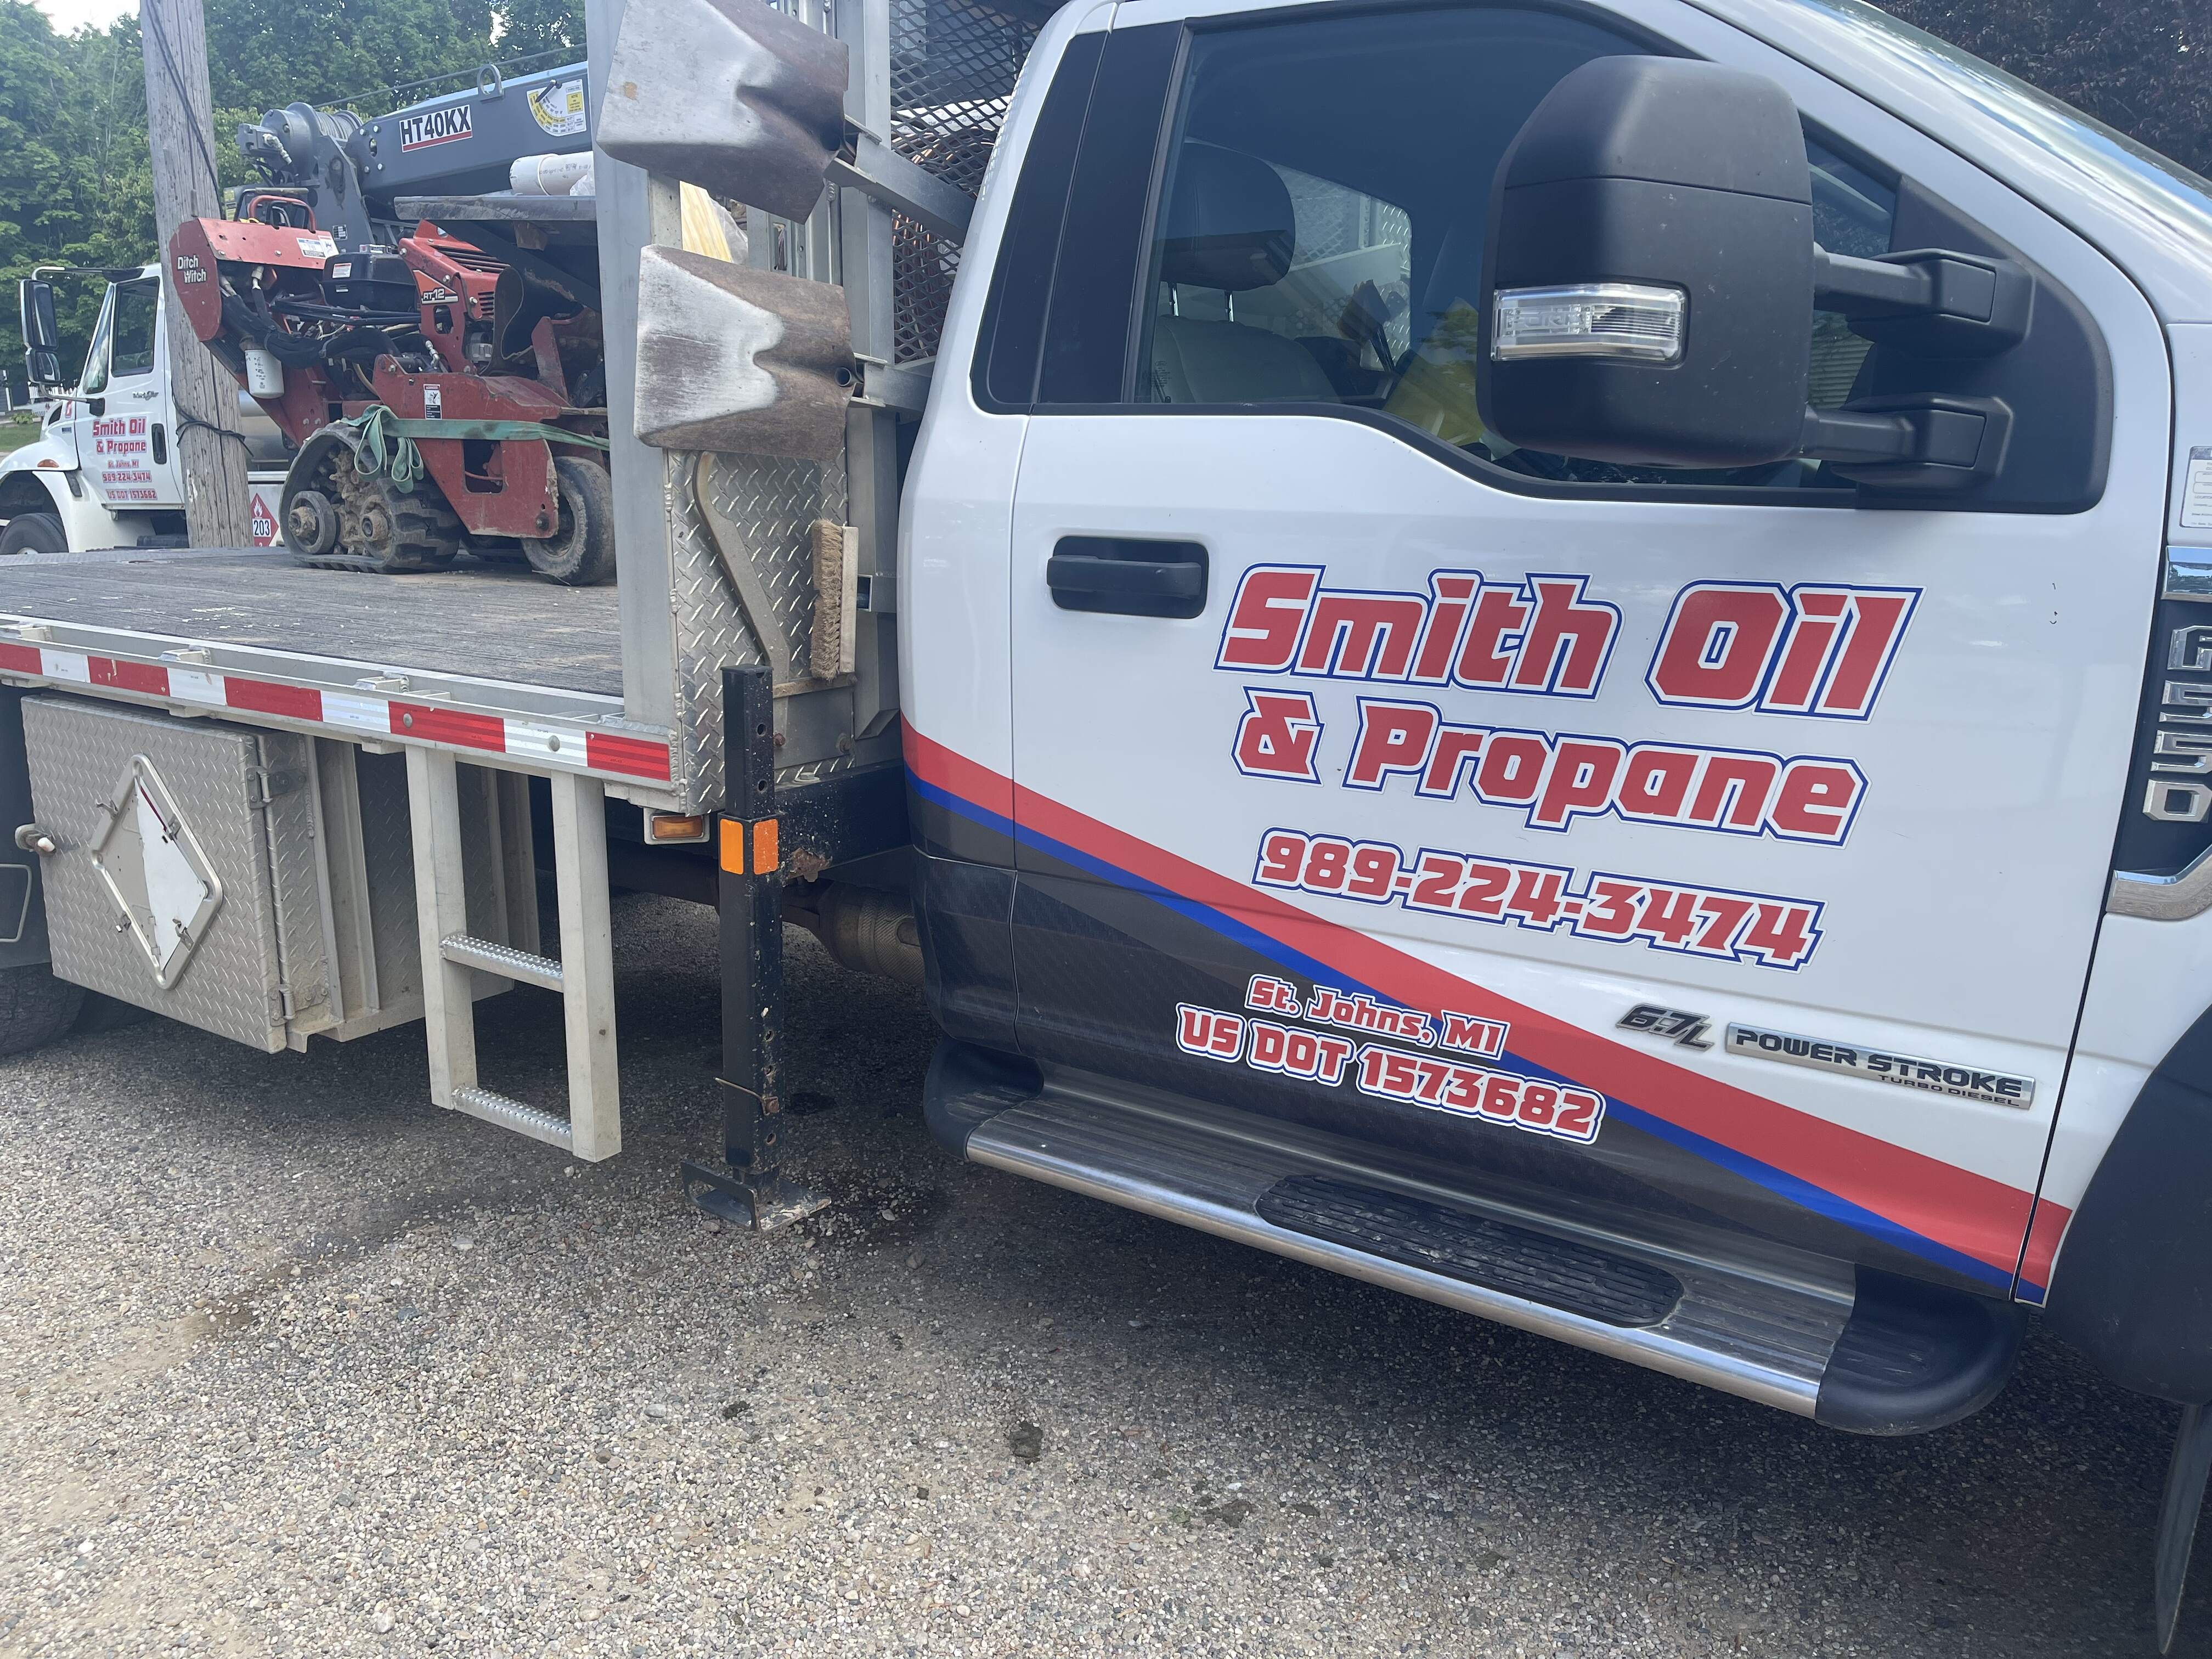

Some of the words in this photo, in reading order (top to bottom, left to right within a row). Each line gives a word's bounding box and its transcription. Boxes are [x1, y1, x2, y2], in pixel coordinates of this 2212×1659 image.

[400, 106, 471, 144] HT40KX
[177, 255, 199, 269] Ditch
[184, 268, 206, 283] Witch
[93, 419, 126, 437] Smith
[129, 417, 146, 435] Oil
[97, 439, 104, 454] &
[106, 439, 146, 455] Propane
[102, 471, 152, 483] 989-224-3474
[106, 488, 116, 500] US
[116, 488, 129, 500] DOT
[129, 488, 157, 500] 1573682
[253, 520, 270, 535] 203
[1214, 563, 1622, 698] Smith
[1645, 580, 1923, 720] Oil
[1232, 687, 1322, 784] &
[1344, 696, 1868, 845] Propane
[1252, 828, 1825, 970] 989-224-3474
[1246, 975, 1300, 1017] St.
[1306, 986, 1437, 1047] Johns,
[1438, 1011, 1509, 1059] MI
[1616, 1003, 1713, 1051] 6.7L
[1178, 1005, 1244, 1060] US
[1248, 1020, 1355, 1085] DOT
[1357, 1045, 1604, 1143] 1573682
[1736, 1029, 1857, 1066] POWER
[1868, 1054, 2022, 1098] STROKE
[1878, 1075, 1943, 1093] TURBO
[1948, 1091, 2019, 1107] DIESEL
